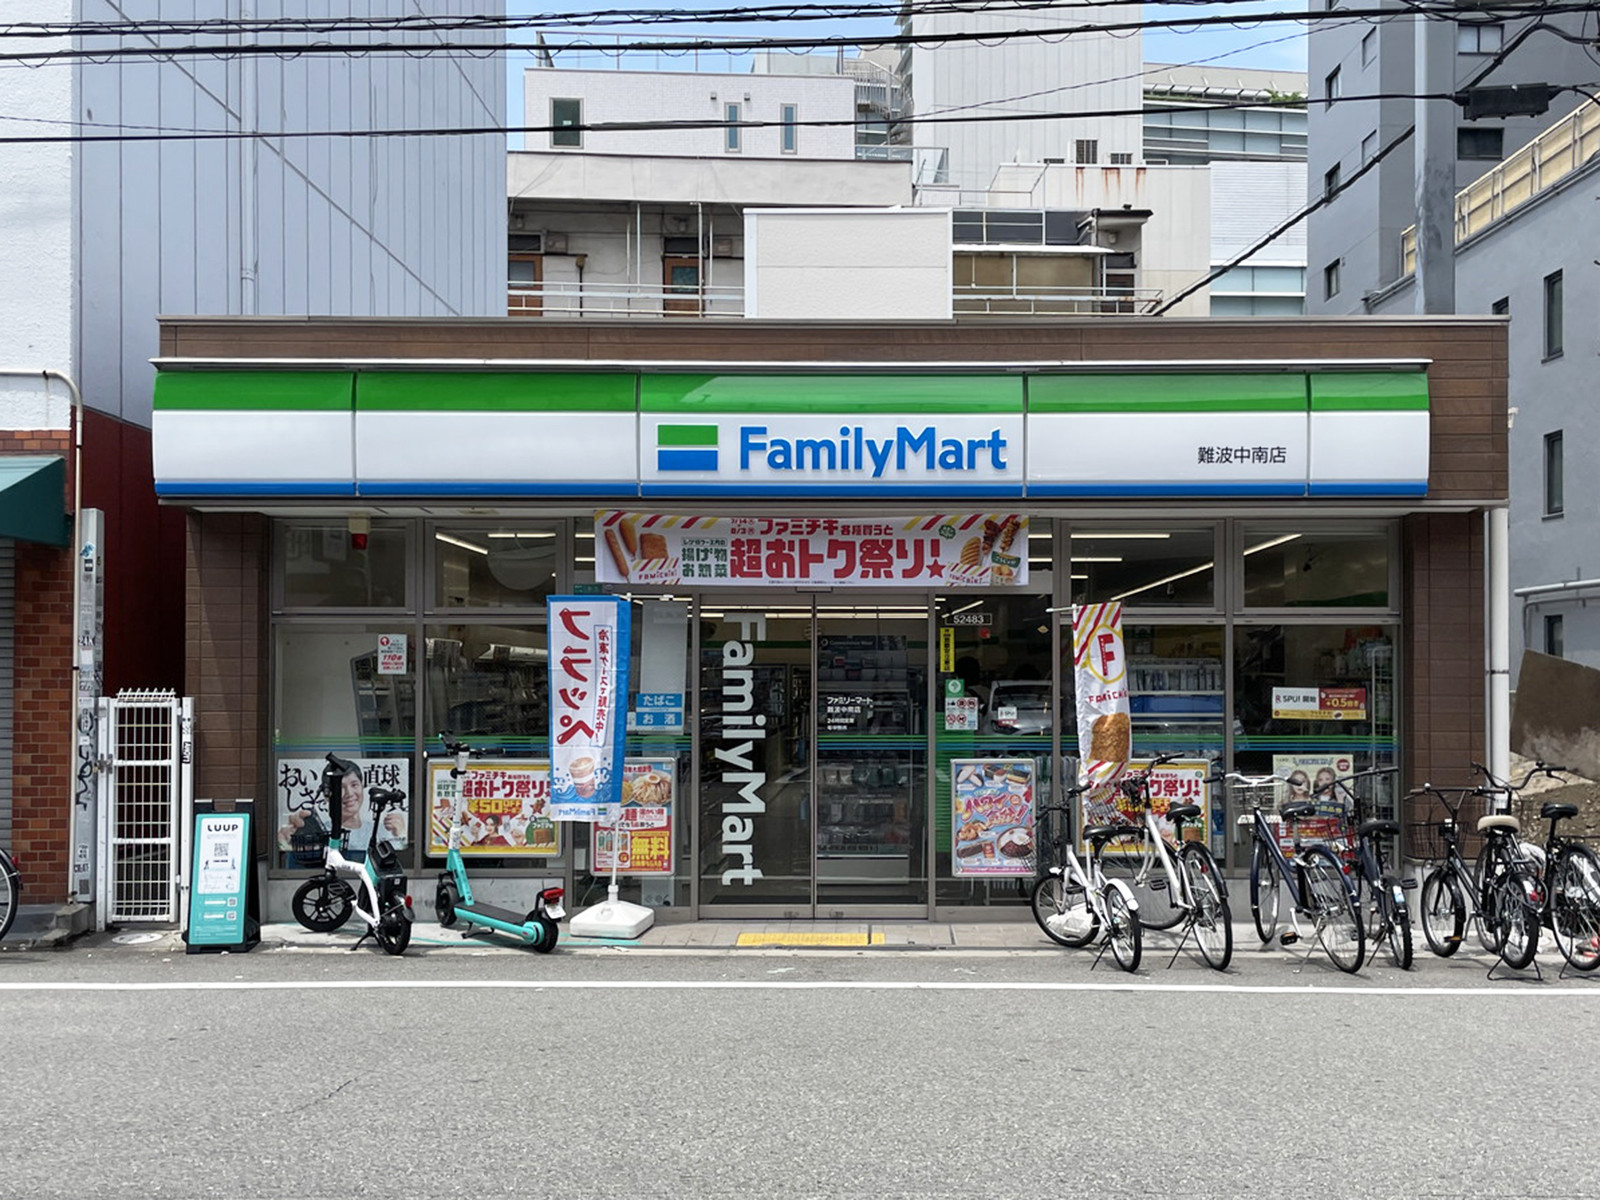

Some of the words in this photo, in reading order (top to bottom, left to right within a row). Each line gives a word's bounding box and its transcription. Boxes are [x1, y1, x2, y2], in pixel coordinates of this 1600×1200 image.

[739, 425, 1008, 478] FamilyMart
[1197, 446, 1287, 464] 難波中南店
[757, 519, 839, 536] ファミチキ
[681, 547, 728, 562] 揚げ物
[953, 615, 984, 624] 52483
[643, 695, 675, 706] たばこ
[827, 696, 873, 705] ファミリーマート
[643, 713, 676, 725] お酒
[715, 613, 766, 885] FamilyMart
[364, 763, 401, 788] 直球
[207, 824, 238, 832] LUUP
[631, 836, 670, 860] 無料
